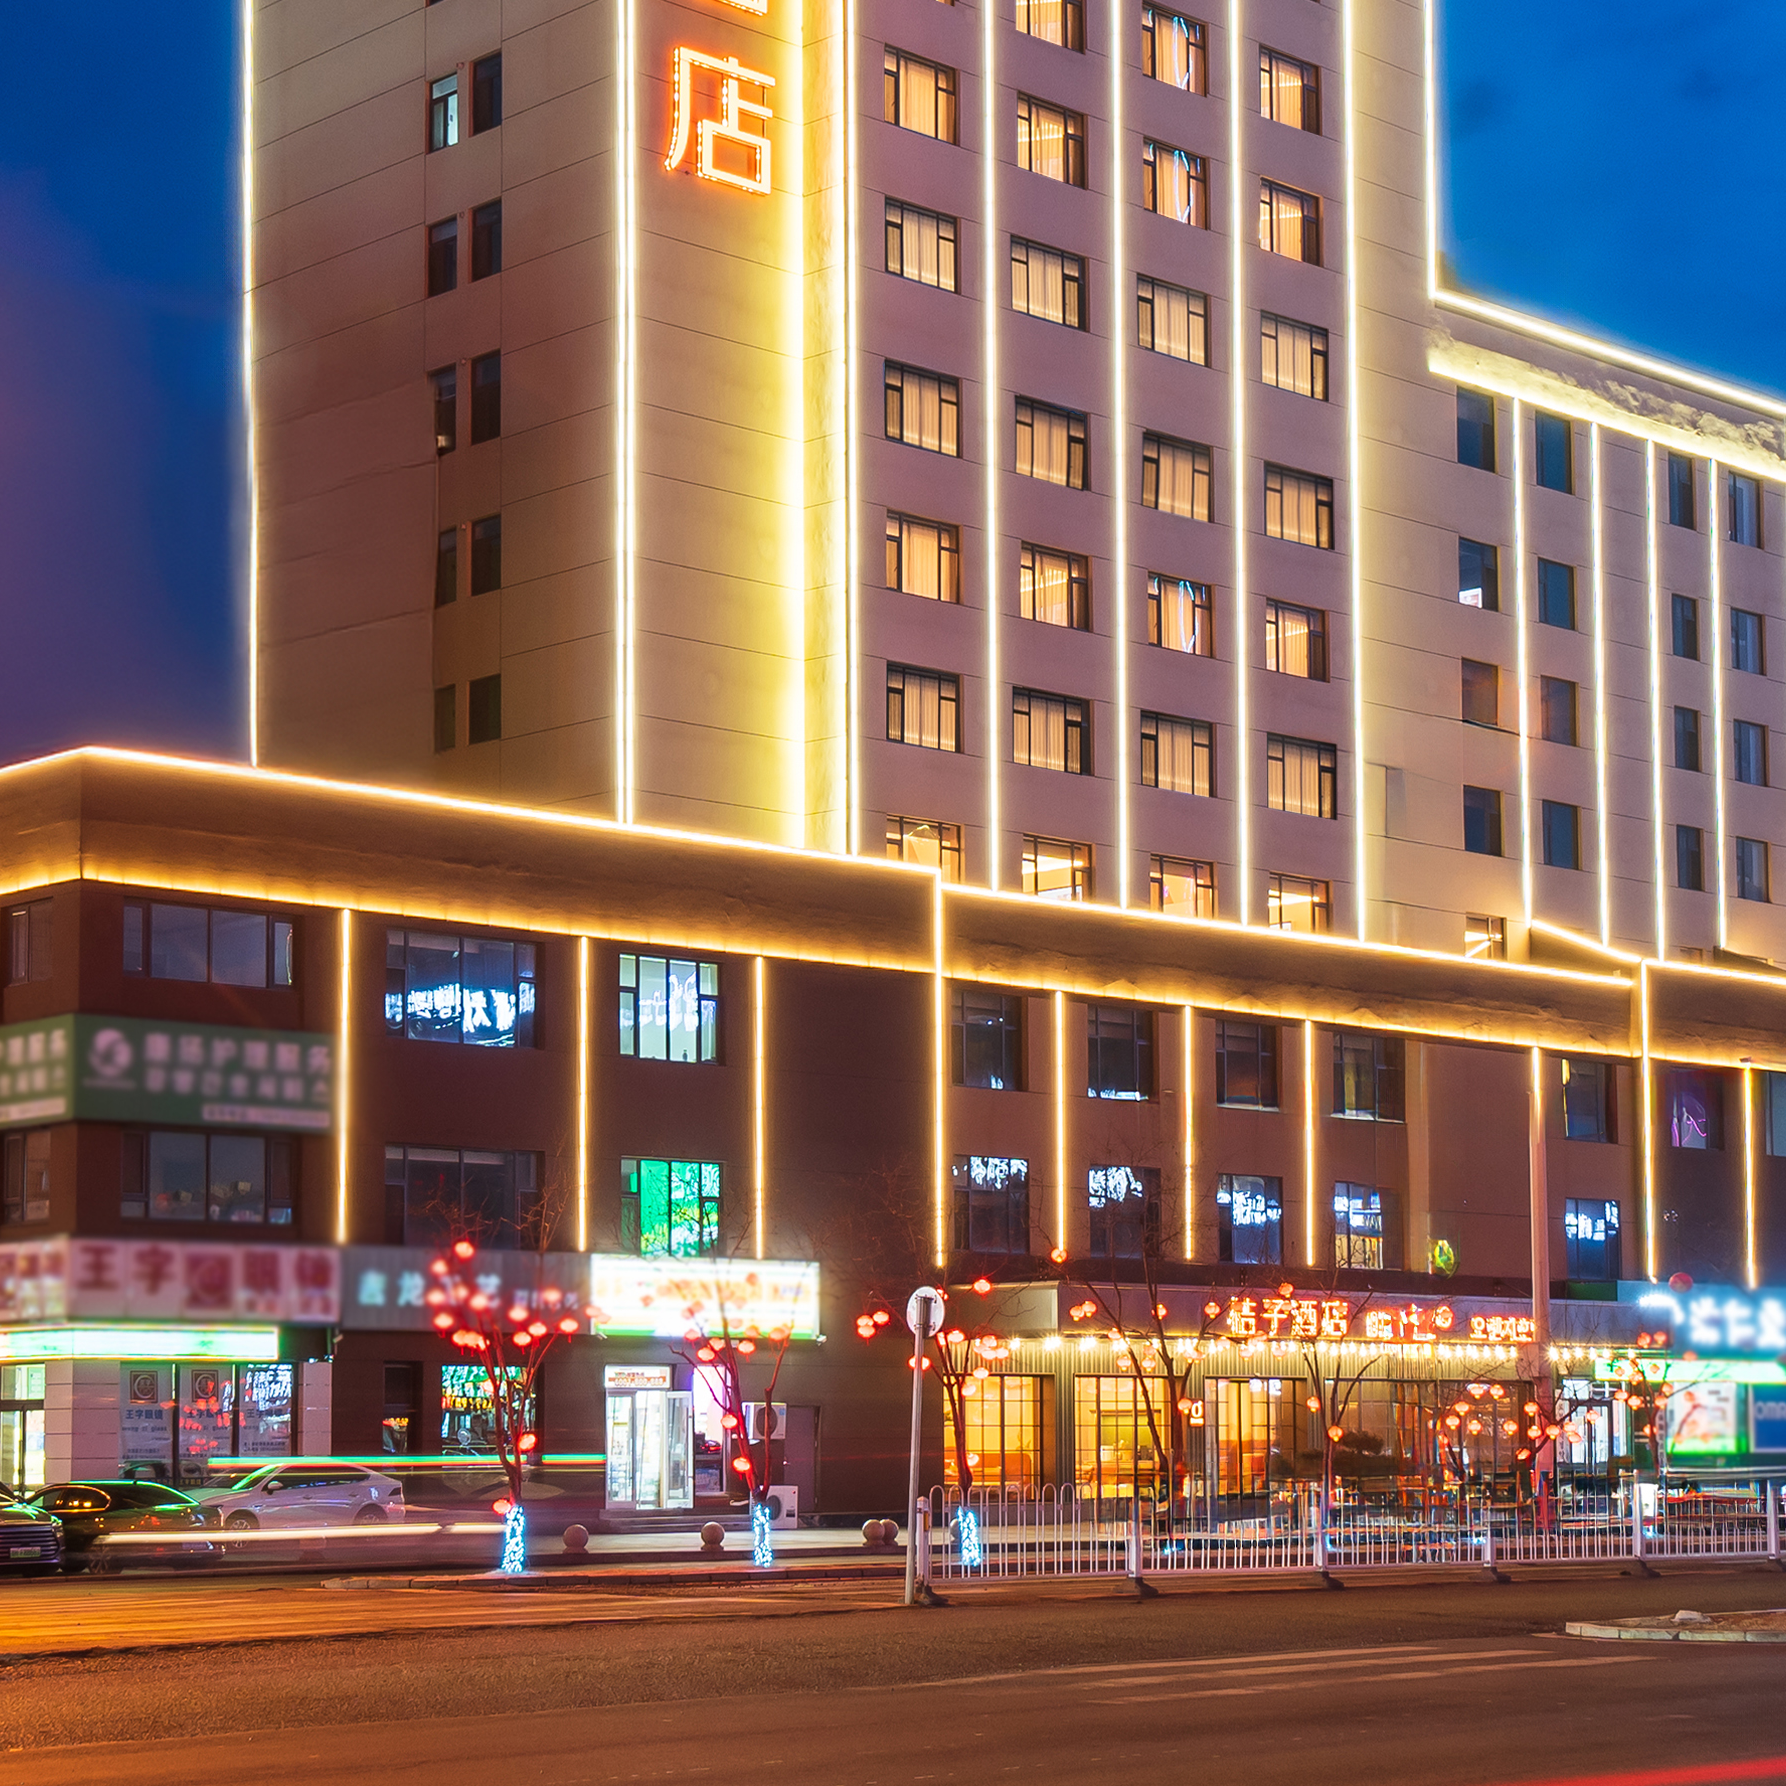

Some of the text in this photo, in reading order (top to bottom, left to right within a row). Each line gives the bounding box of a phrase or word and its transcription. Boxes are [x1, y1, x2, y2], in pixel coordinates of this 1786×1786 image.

[1227, 1296, 1348, 1338] 桔子酒店
[1469, 1316, 1536, 1342] 오렌지호
